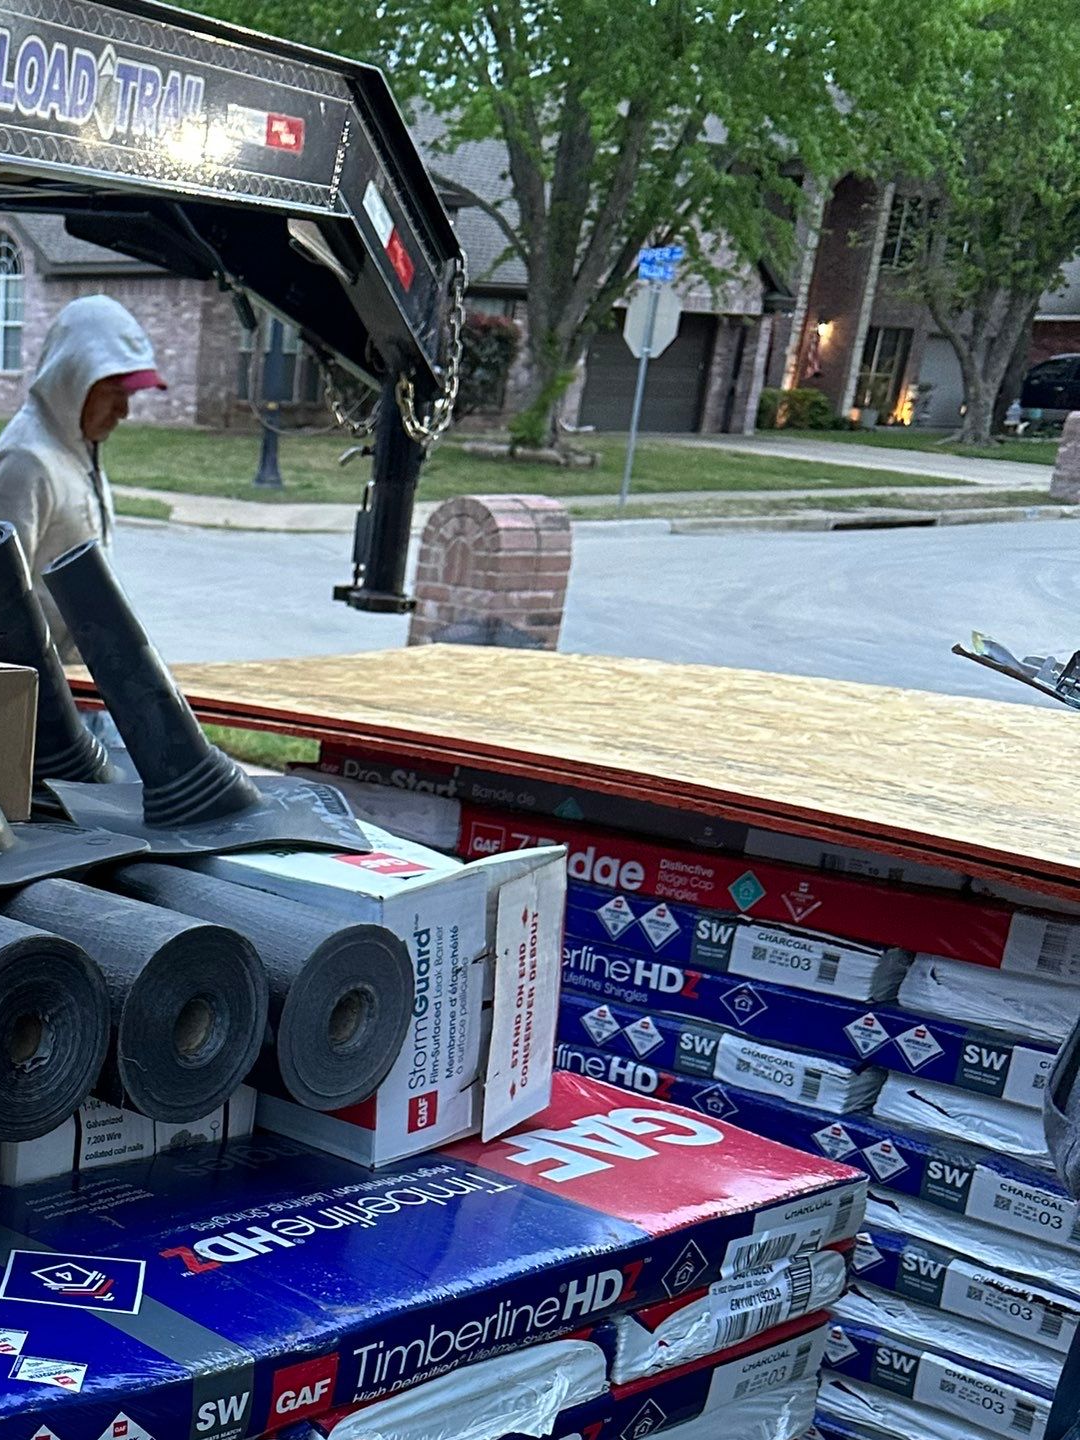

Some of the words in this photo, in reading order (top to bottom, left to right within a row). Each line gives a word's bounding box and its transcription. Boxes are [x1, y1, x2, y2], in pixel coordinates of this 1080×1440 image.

[659, 858, 715, 878] Distinctive
[654, 884, 699, 902] Shingles
[657, 871, 687, 888] Ridge
[688, 879, 715, 893] Cap
[696, 919, 735, 945] SW
[757, 931, 815, 954] CHARCOAL
[518, 942, 527, 979] END
[789, 955, 812, 972] 03
[433, 972, 444, 999] Leak
[603, 982, 649, 1003] Shingles
[515, 989, 524, 1010] ON
[520, 990, 536, 1088] CONSERVER
[529, 911, 540, 982] DEBOUT
[429, 1001, 443, 1084] Film-Surfaced
[445, 1012, 458, 1080] Membrane
[456, 1024, 466, 1063] surface
[510, 1029, 521, 1070] STAND
[963, 1044, 1009, 1071] SW
[85, 1115, 124, 1130] Galvanized
[416, 1097, 428, 1128] GAF
[85, 1147, 113, 1161] collated
[127, 1142, 144, 1153] nails
[86, 1135, 105, 1146] 7,200
[105, 1132, 122, 1143] Wire
[501, 1108, 725, 1183] GAF
[411, 1164, 457, 1179] High
[926, 1161, 970, 1188] SW
[268, 1191, 327, 1213] Lifetime
[999, 1183, 1066, 1213] CHARCOAL
[190, 1206, 270, 1232] Shingles
[1038, 1211, 1063, 1230] 03
[1008, 1302, 1033, 1322] 03
[876, 1347, 917, 1375] SW
[944, 1368, 1007, 1399] CHARCOAL
